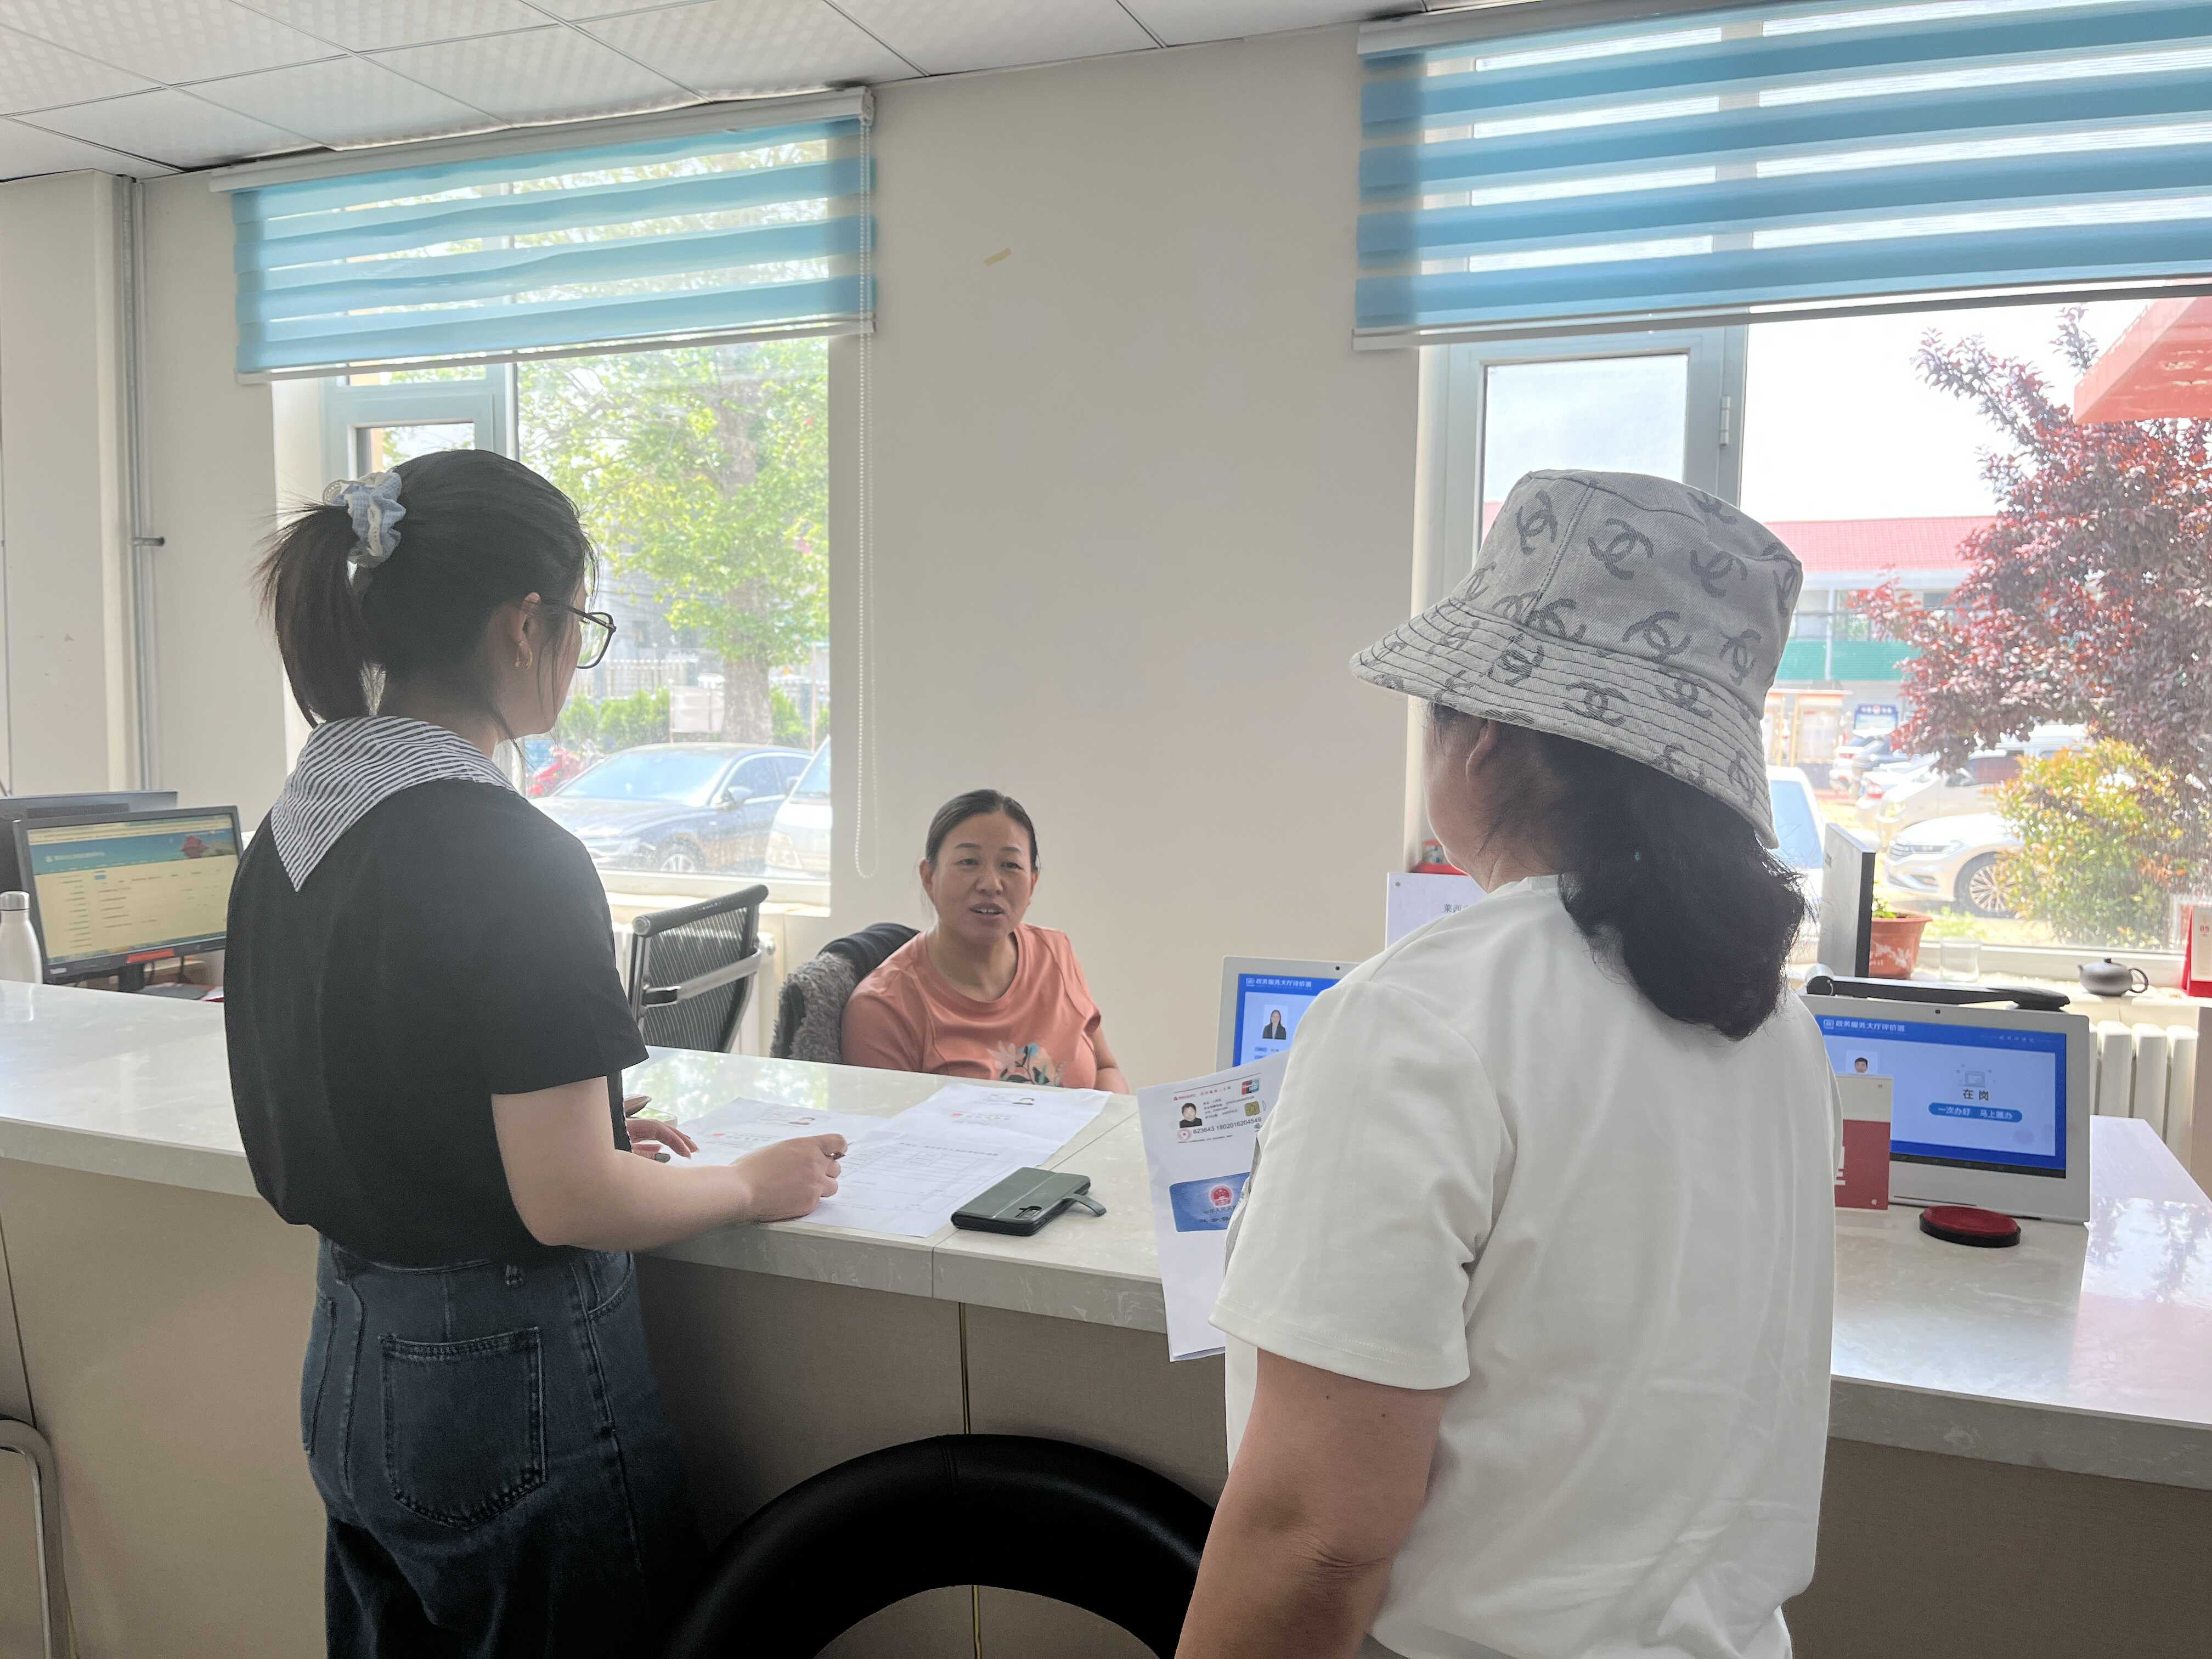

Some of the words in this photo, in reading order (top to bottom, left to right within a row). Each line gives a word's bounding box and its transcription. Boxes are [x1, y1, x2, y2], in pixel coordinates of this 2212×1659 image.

[1962, 1089, 1989, 1101] 在岗
[1938, 1105, 1971, 1116] 一次办好
